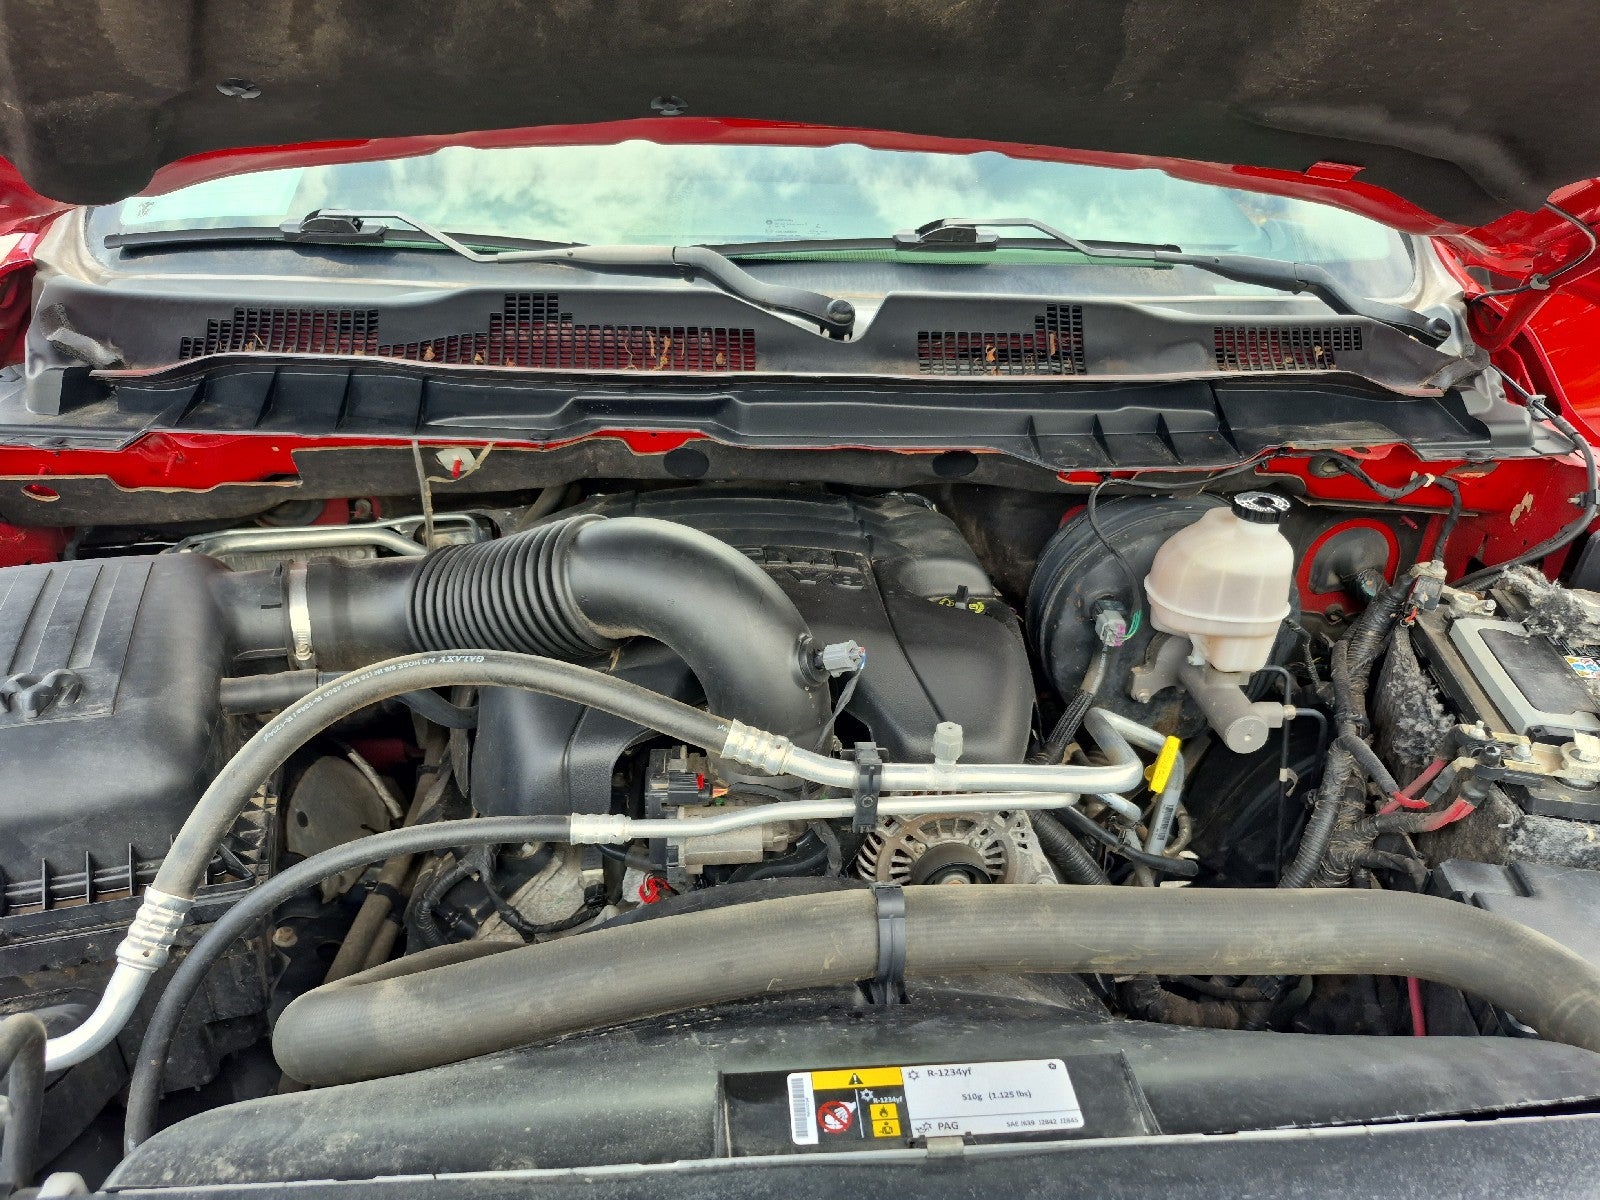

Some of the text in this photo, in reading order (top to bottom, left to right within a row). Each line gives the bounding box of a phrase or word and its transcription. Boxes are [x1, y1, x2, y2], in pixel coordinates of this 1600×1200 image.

[439, 654, 485, 664] GALAXY
[397, 660, 421, 670] HOSE
[927, 1067, 972, 1079] R-1234yf
[872, 1095, 903, 1104] R-1234yf
[961, 1089, 1032, 1102] 510g (1.125 lbs)
[937, 1121, 959, 1131] PAG
[1006, 1120, 1019, 1128] SAE
